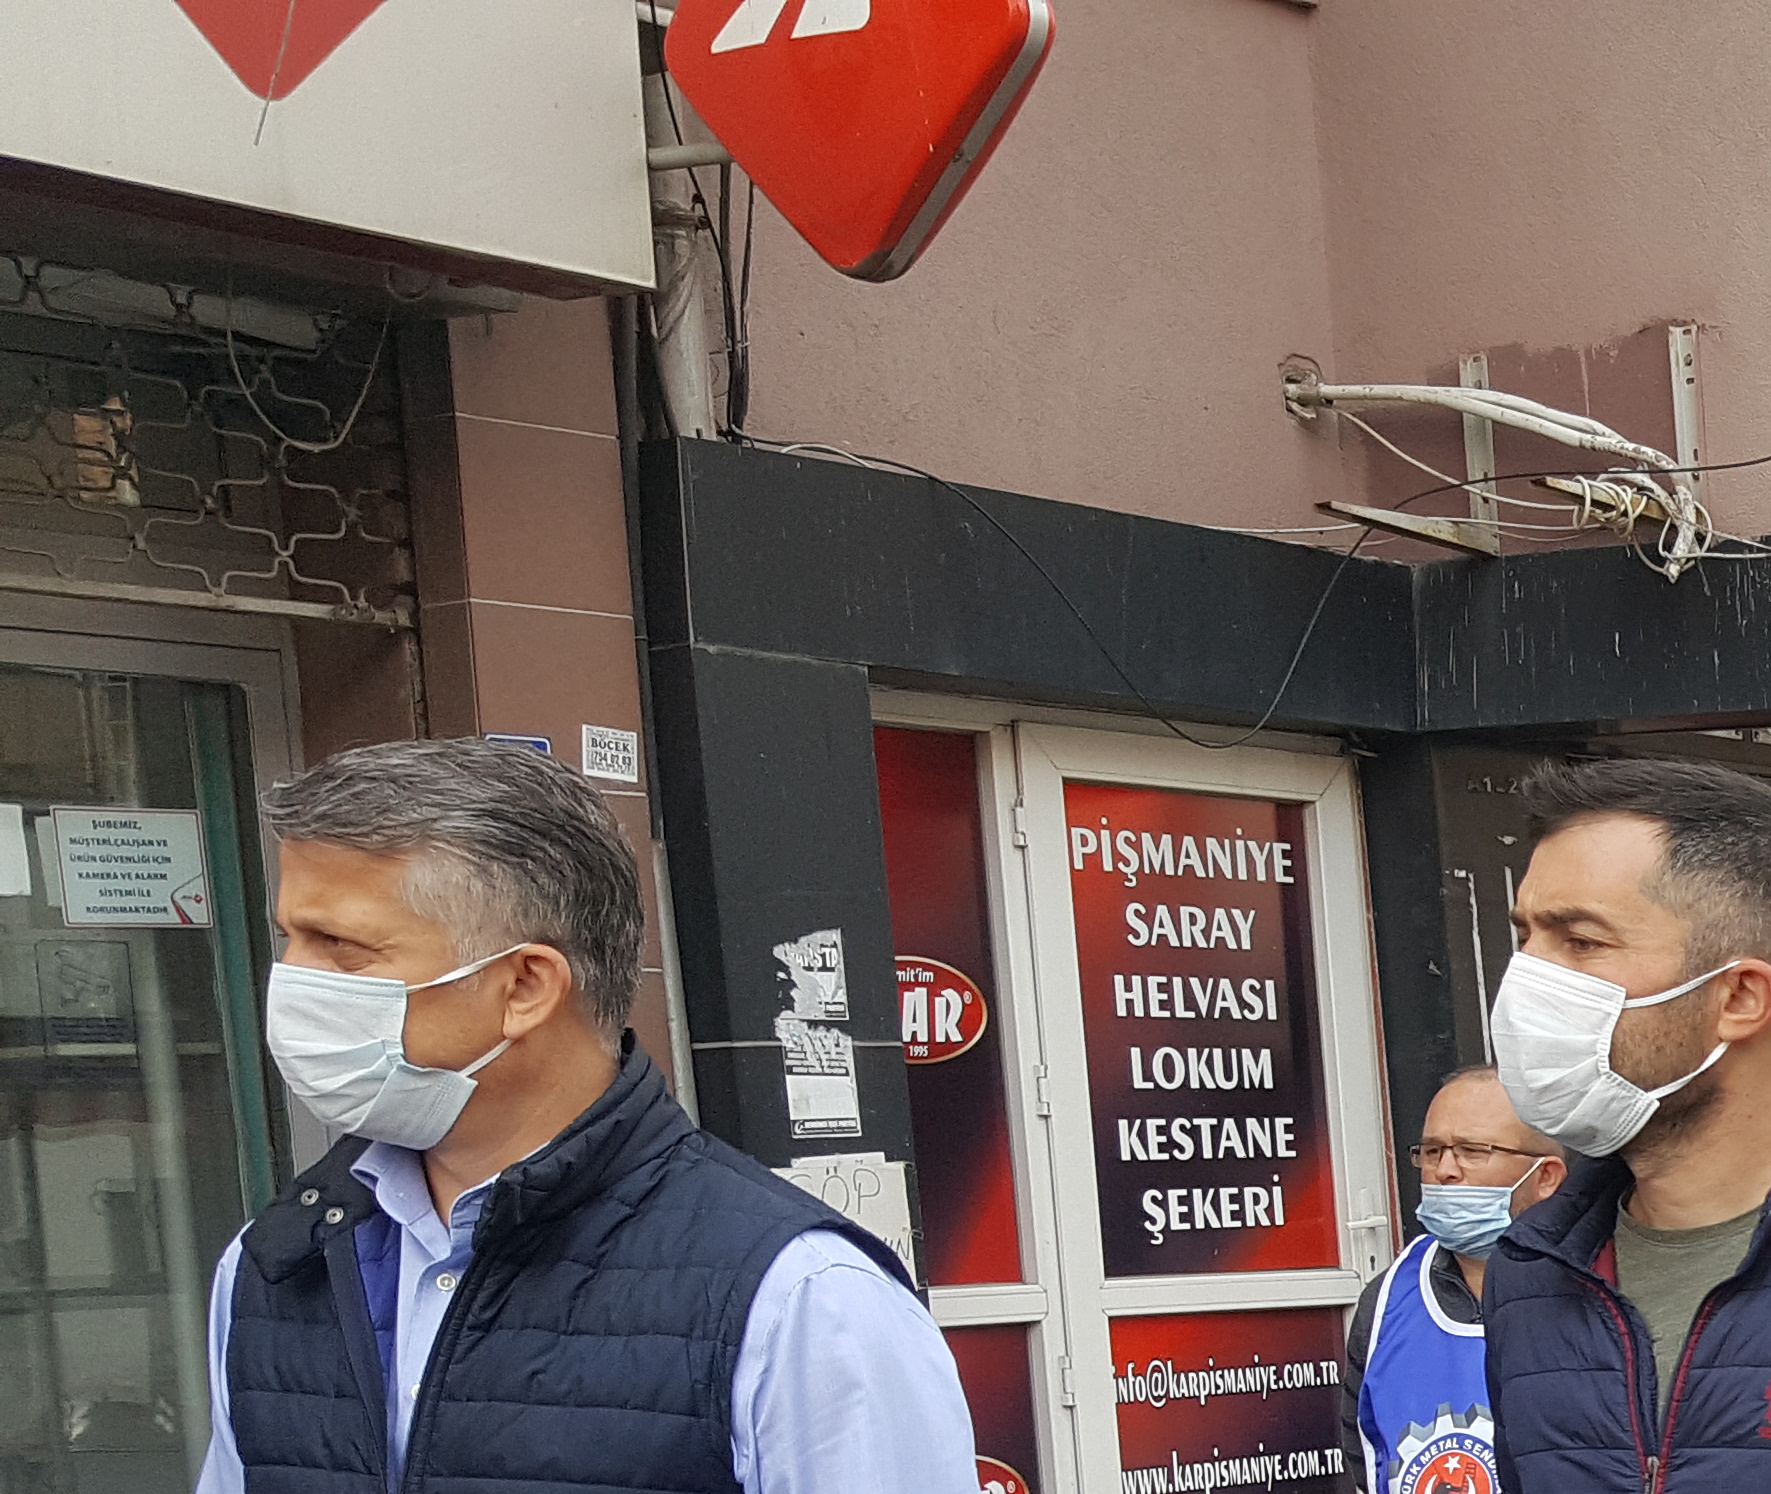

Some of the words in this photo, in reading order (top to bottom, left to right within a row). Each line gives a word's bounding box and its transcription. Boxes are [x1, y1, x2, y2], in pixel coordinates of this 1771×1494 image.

[1071, 816, 1295, 888] PİŞMANİYE
[1125, 902, 1256, 950] SARAY
[902, 987, 964, 1043] AR
[1113, 974, 1277, 1021] HELVASI
[908, 1045, 929, 1057] 1995
[1130, 1046, 1274, 1090] LOKUM
[1118, 1117, 1297, 1161] KESTANE
[1142, 1174, 1285, 1245] ŞEKERİ
[1419, 1437, 1460, 1466] METAL
